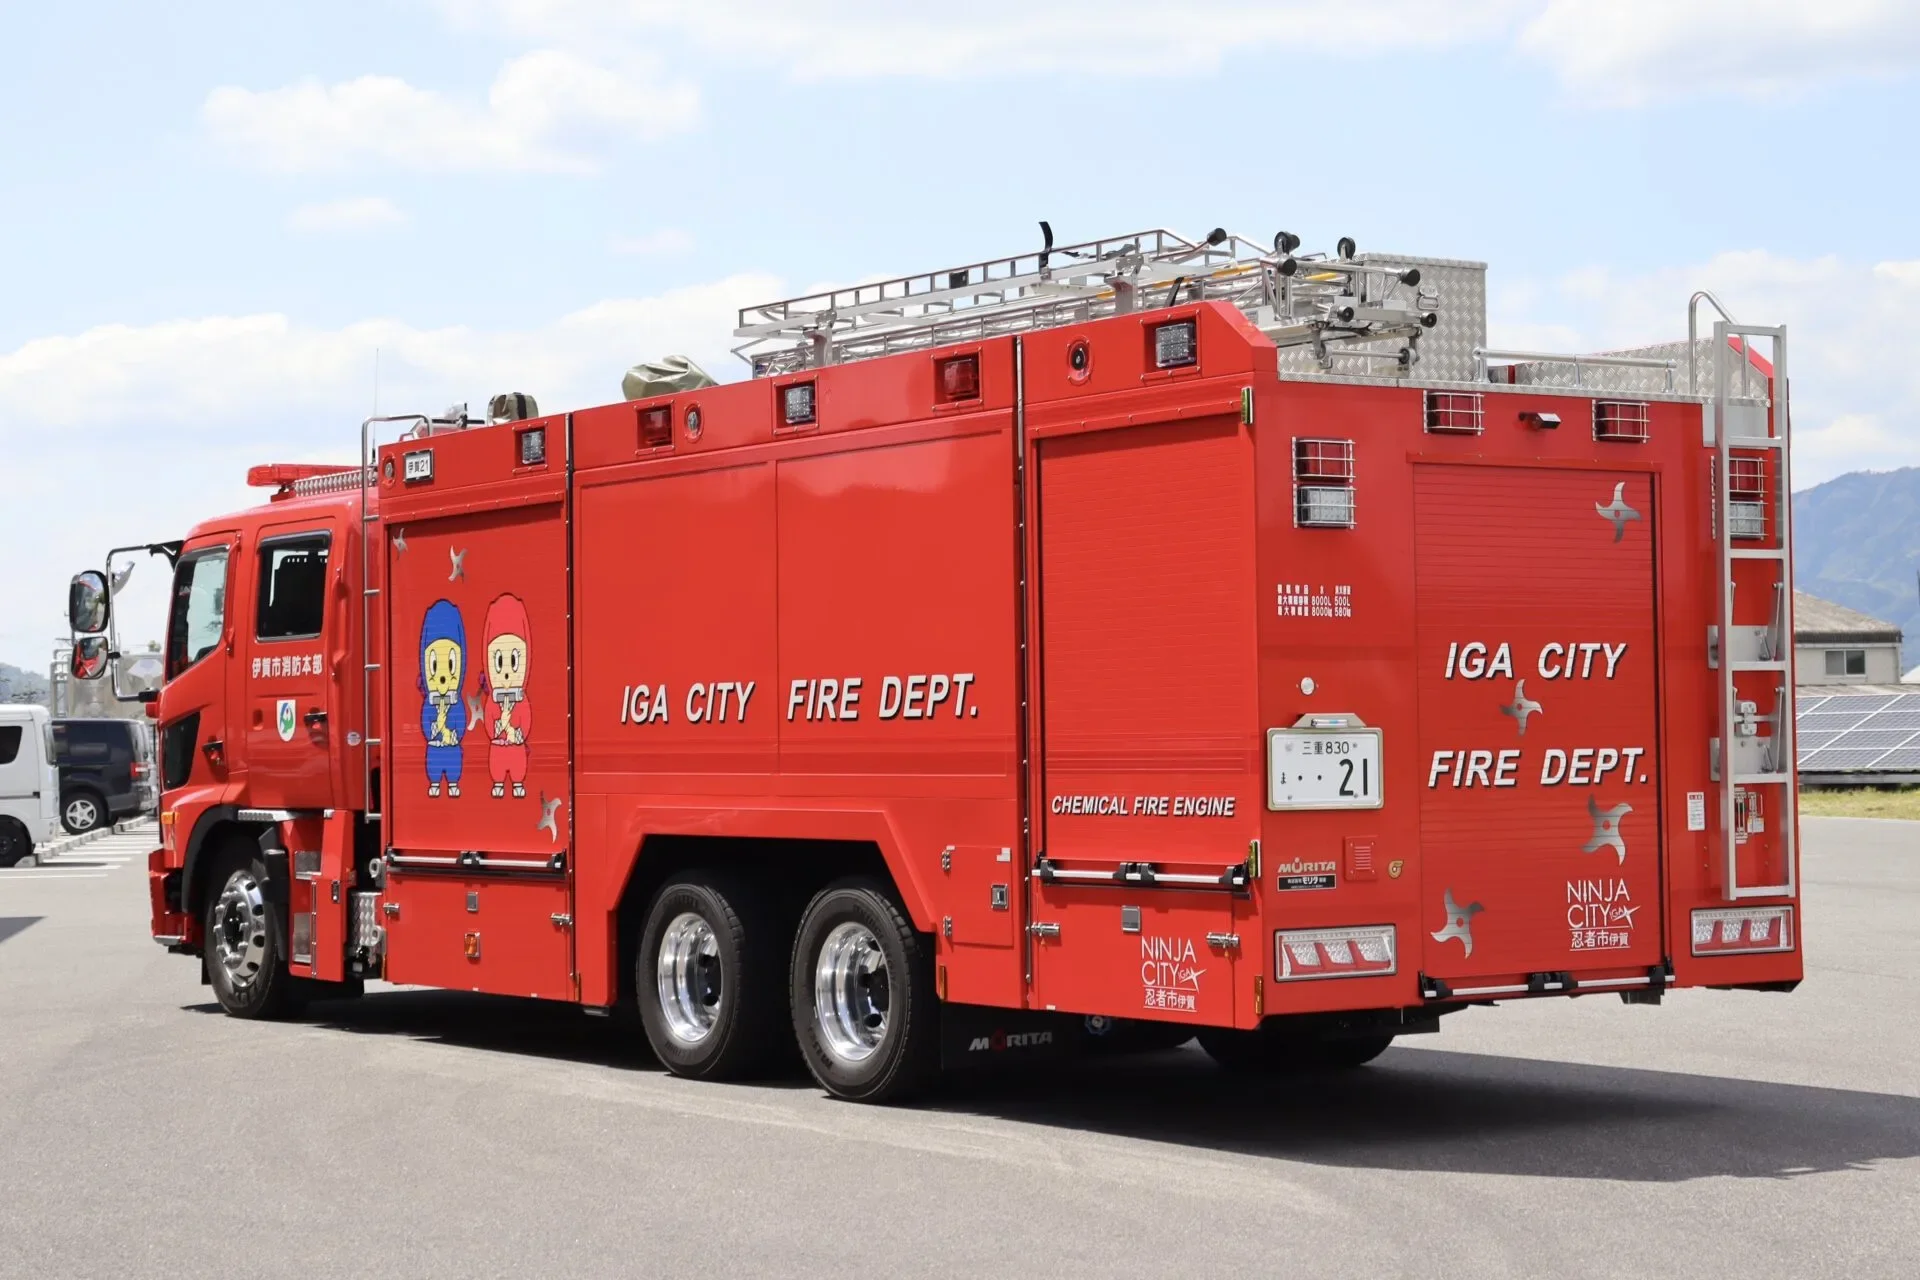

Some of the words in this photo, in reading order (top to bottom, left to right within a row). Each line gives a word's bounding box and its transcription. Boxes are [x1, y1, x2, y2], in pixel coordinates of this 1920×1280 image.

[1311, 595, 1332, 607] 8000L
[1334, 595, 1350, 607] 500L
[252, 654, 323, 679] 伊賀市消防本部
[1444, 641, 1514, 680] IGA
[1537, 642, 1627, 680] CITY
[620, 684, 669, 724] IGA
[685, 681, 755, 723] CITY
[787, 677, 862, 721] FIRE
[878, 672, 978, 719] DEPT.
[1428, 750, 1521, 788] FIRE
[1540, 747, 1649, 786] DEPT.
[1051, 795, 1129, 815] CHEMICAL
[1133, 796, 1170, 816] FIRE
[1173, 796, 1236, 818] ENGINE
[1567, 878, 1630, 904] NINJA
[1567, 903, 1611, 928] CITY
[1141, 935, 1197, 963] NINJA
[1571, 930, 1629, 948] 忍者市伊賀
[1141, 960, 1180, 987] CITY
[1144, 988, 1196, 1010] 忍者市伊賀
